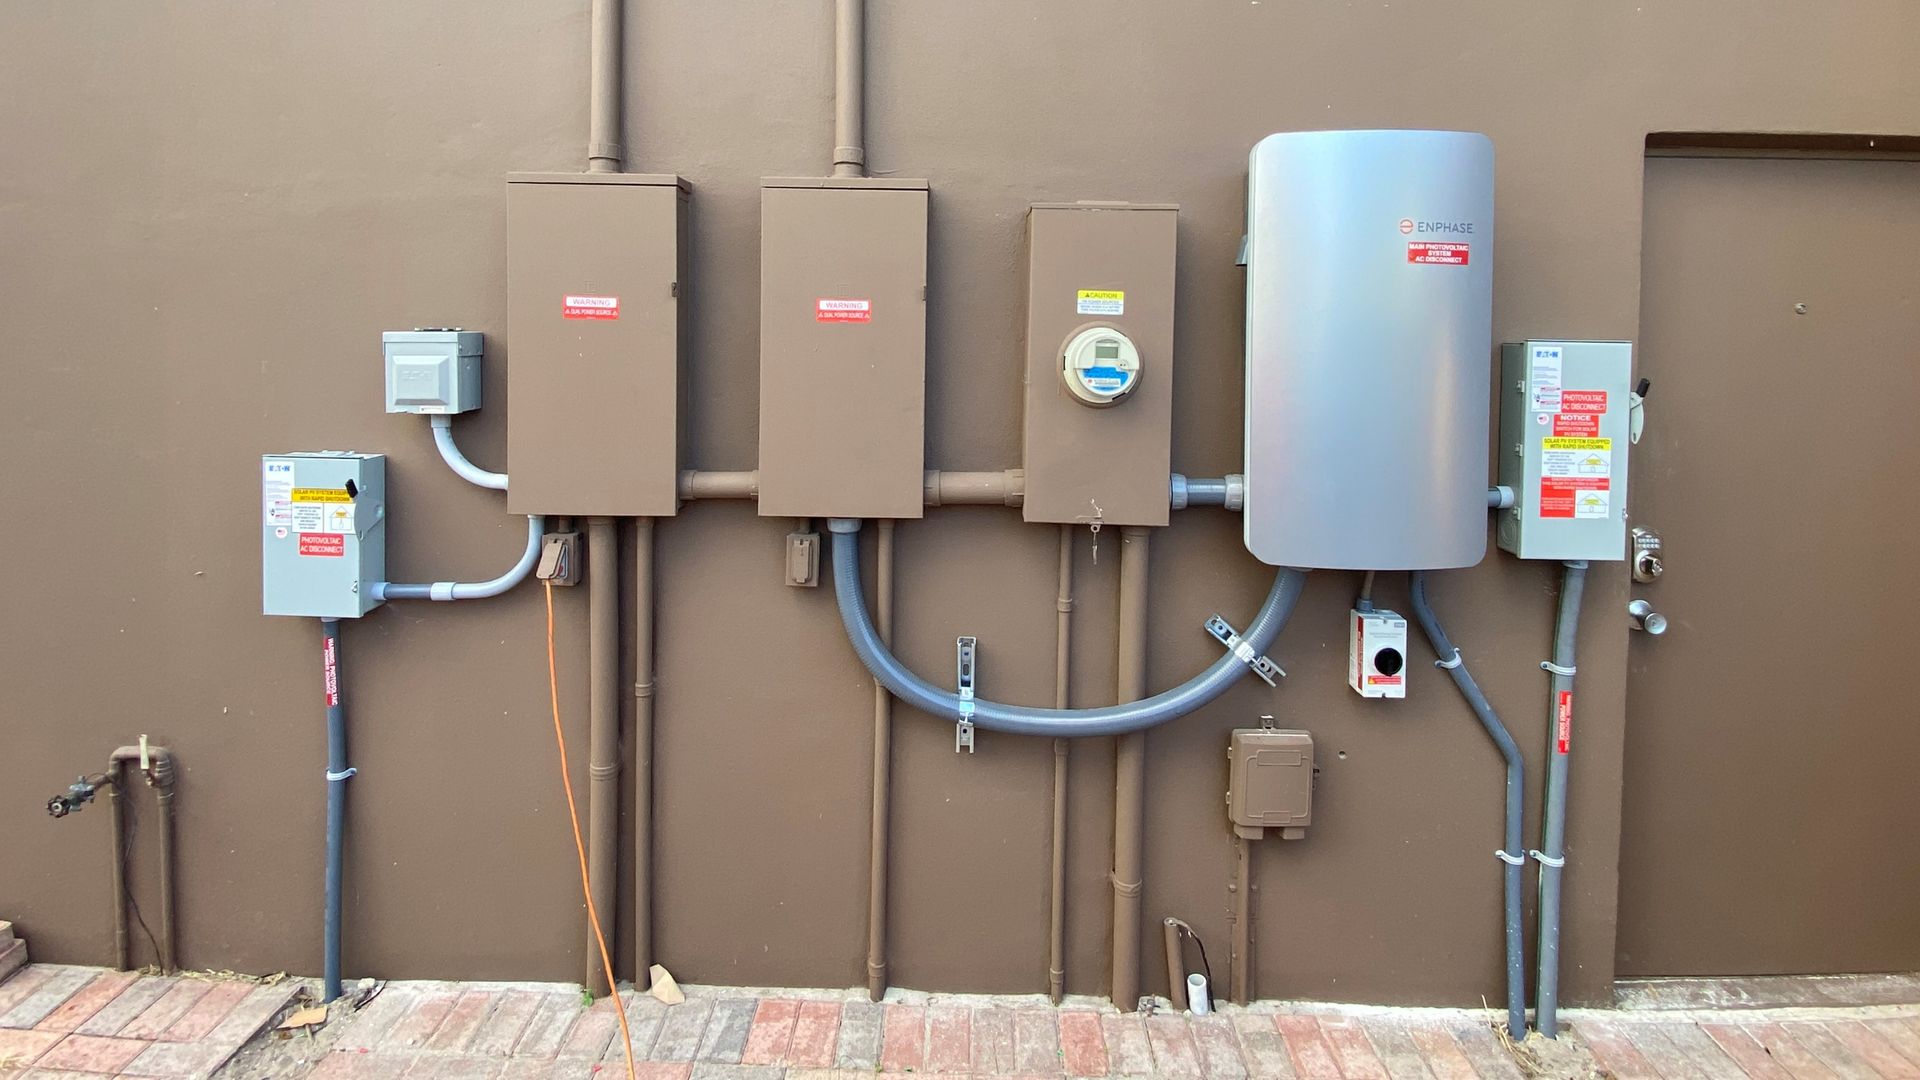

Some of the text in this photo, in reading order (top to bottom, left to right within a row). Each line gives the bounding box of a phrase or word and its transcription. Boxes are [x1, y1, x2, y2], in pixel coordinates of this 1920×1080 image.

[1417, 221, 1474, 234] ENPHASE
[572, 298, 611, 306] WARNING
[1563, 394, 1605, 402] PHOTOVOLTAIC
[301, 536, 342, 545] PHOTOVOLTAIC
[329, 665, 338, 706] PHOTOVOLTAIC
